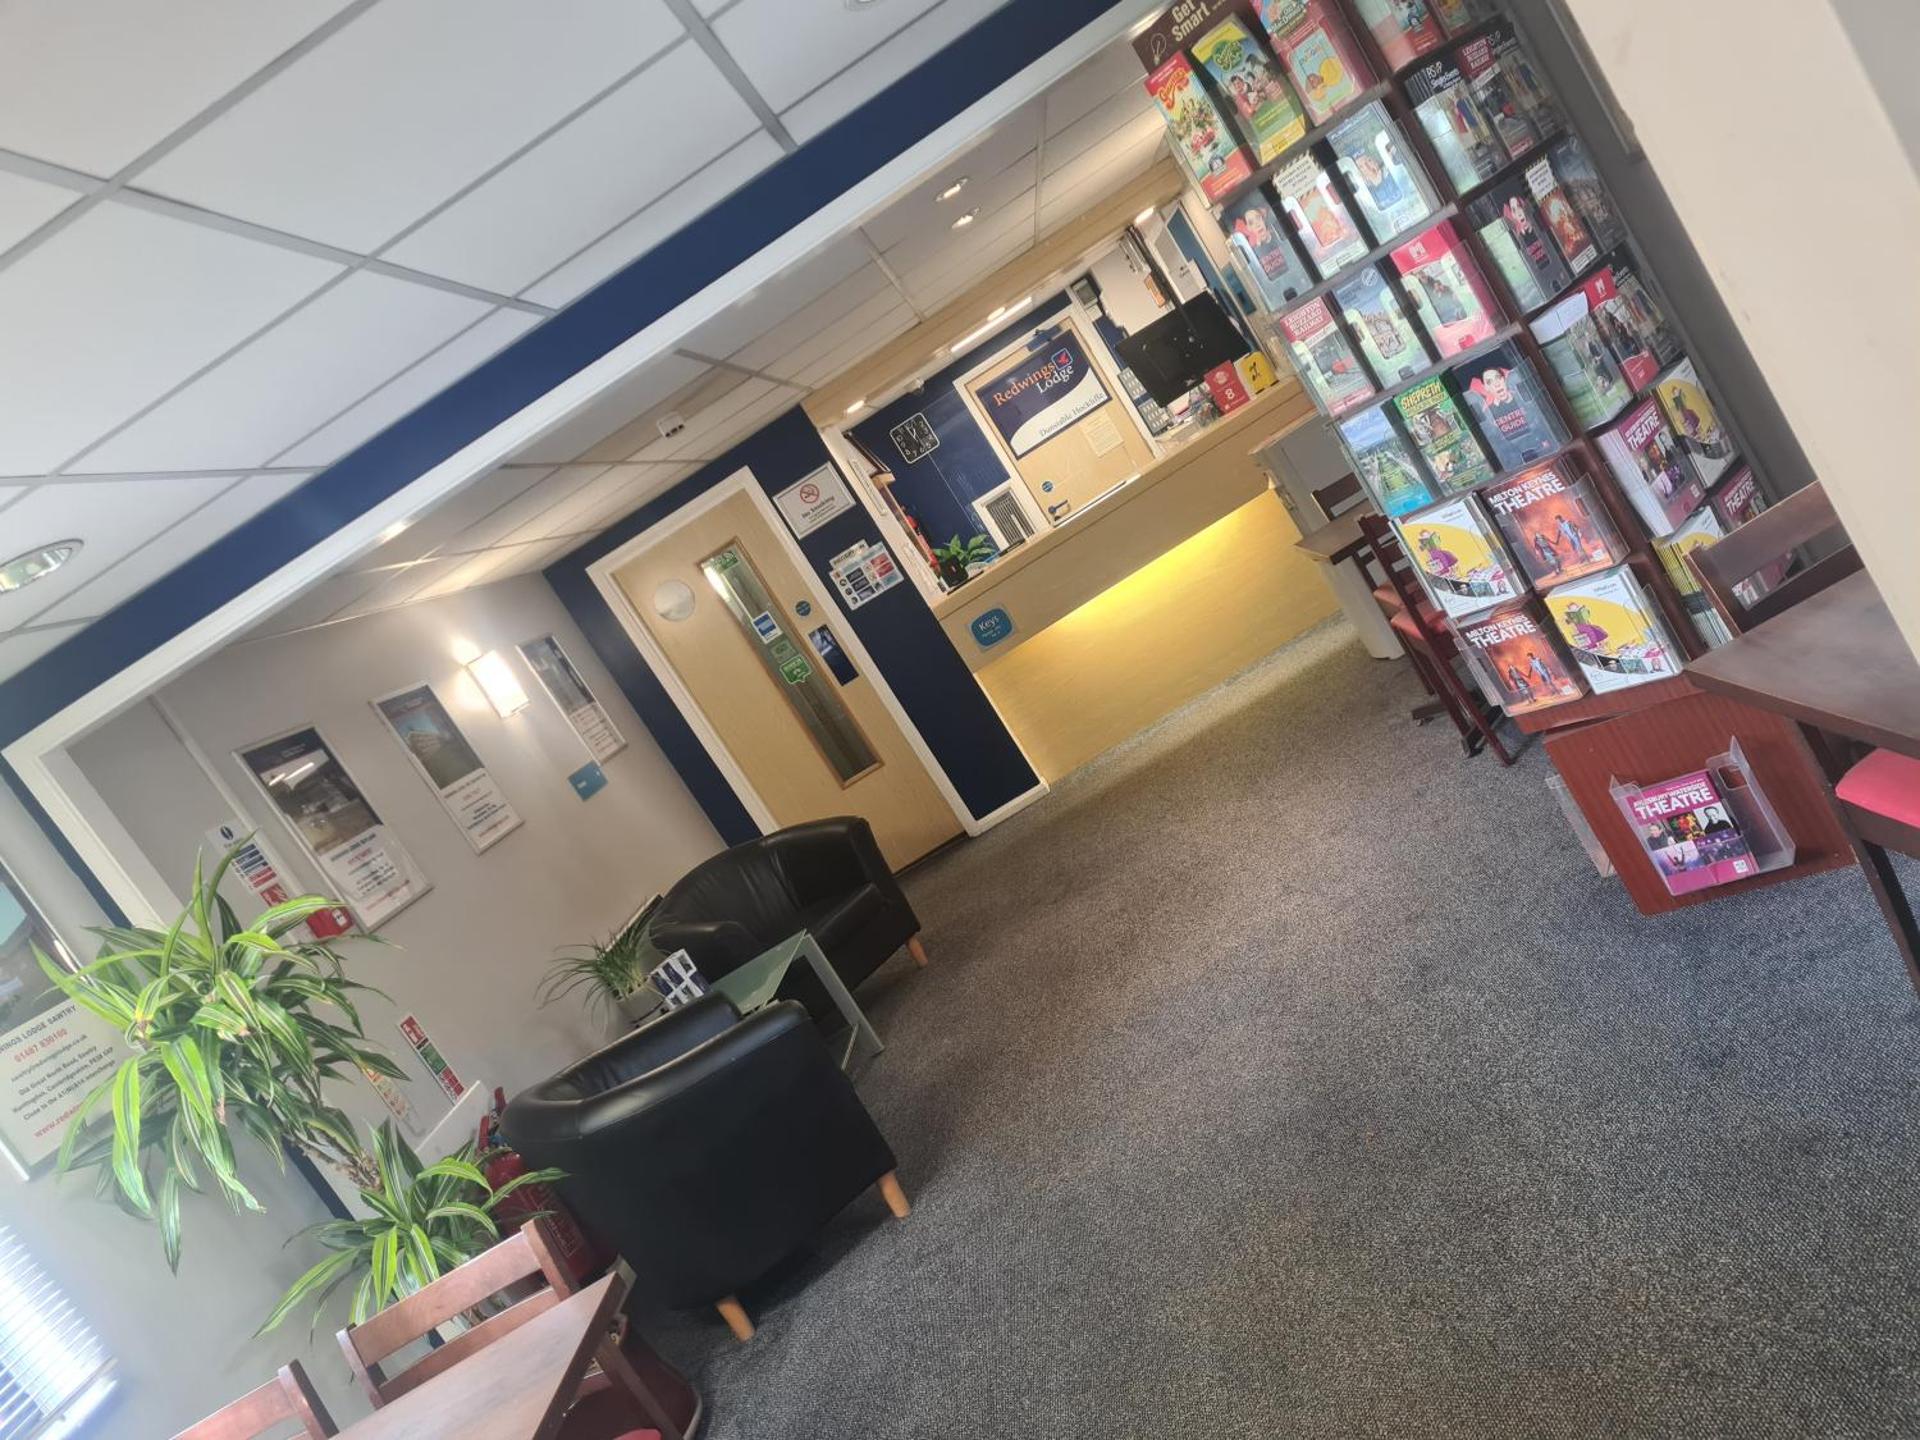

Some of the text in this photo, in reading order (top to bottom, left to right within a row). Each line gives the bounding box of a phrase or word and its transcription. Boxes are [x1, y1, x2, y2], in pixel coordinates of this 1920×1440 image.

[1170, 0, 1196, 23] Get
[1171, 0, 1211, 42] Smart
[1283, 300, 1320, 326] LEIGHTON
[1288, 307, 1322, 331] BUZZARD
[1291, 315, 1324, 336] RAILWAY
[992, 361, 1056, 406] Redwings
[1034, 364, 1074, 394] Lodge
[1400, 381, 1442, 409] SHEPRETH
[1500, 416, 1526, 432] GUIDE
[1627, 411, 1660, 449] THEATRE
[1488, 470, 1556, 504] MILTON KEYNES
[1493, 477, 1565, 515] THEATRE
[1725, 476, 1755, 515] THEATRE
[809, 495, 834, 513] Smoking
[977, 614, 999, 631] Keys
[1464, 623, 1497, 639] MILTON
[1469, 620, 1536, 649] THEATRE
[1634, 787, 1713, 819] THEATRE
[46, 1004, 76, 1025] SAWTRY
